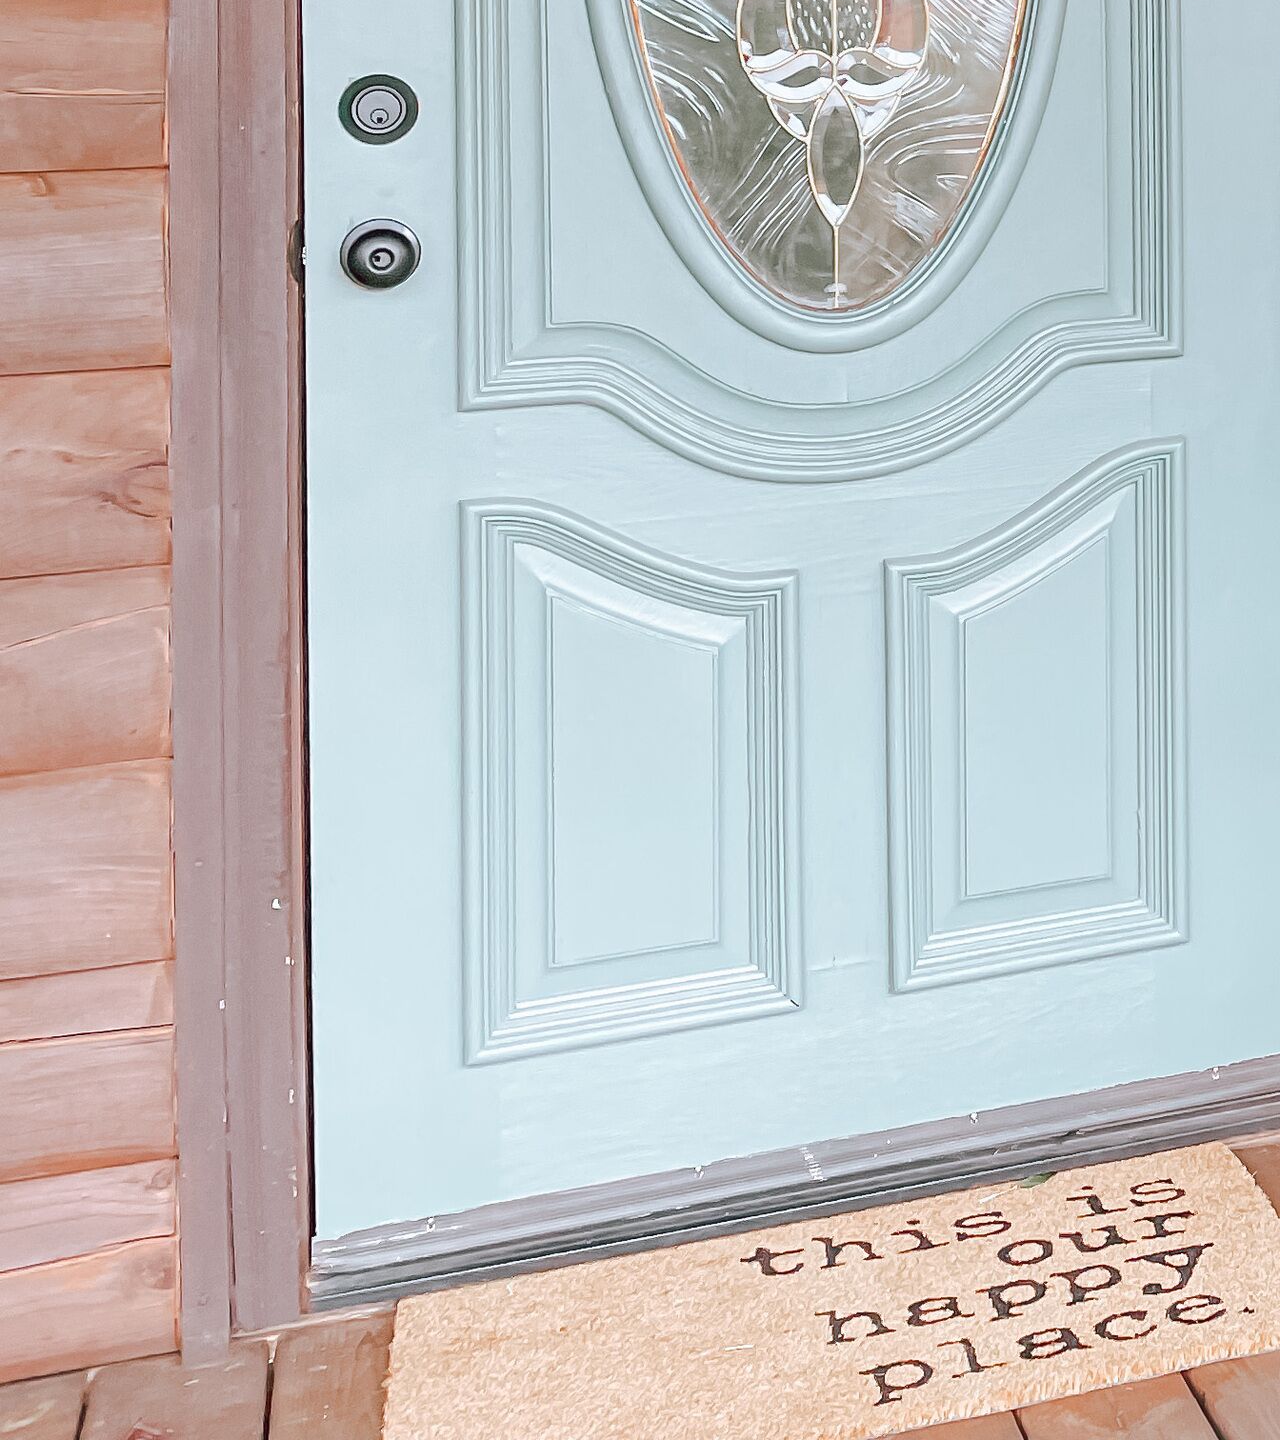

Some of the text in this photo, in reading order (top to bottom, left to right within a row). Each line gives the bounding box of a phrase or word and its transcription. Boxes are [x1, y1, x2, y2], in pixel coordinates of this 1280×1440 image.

[741, 1177, 1187, 1277] this is
[997, 1210, 1200, 1267] our
[814, 1242, 1215, 1346] happy
[858, 1292, 1256, 1407] place.
